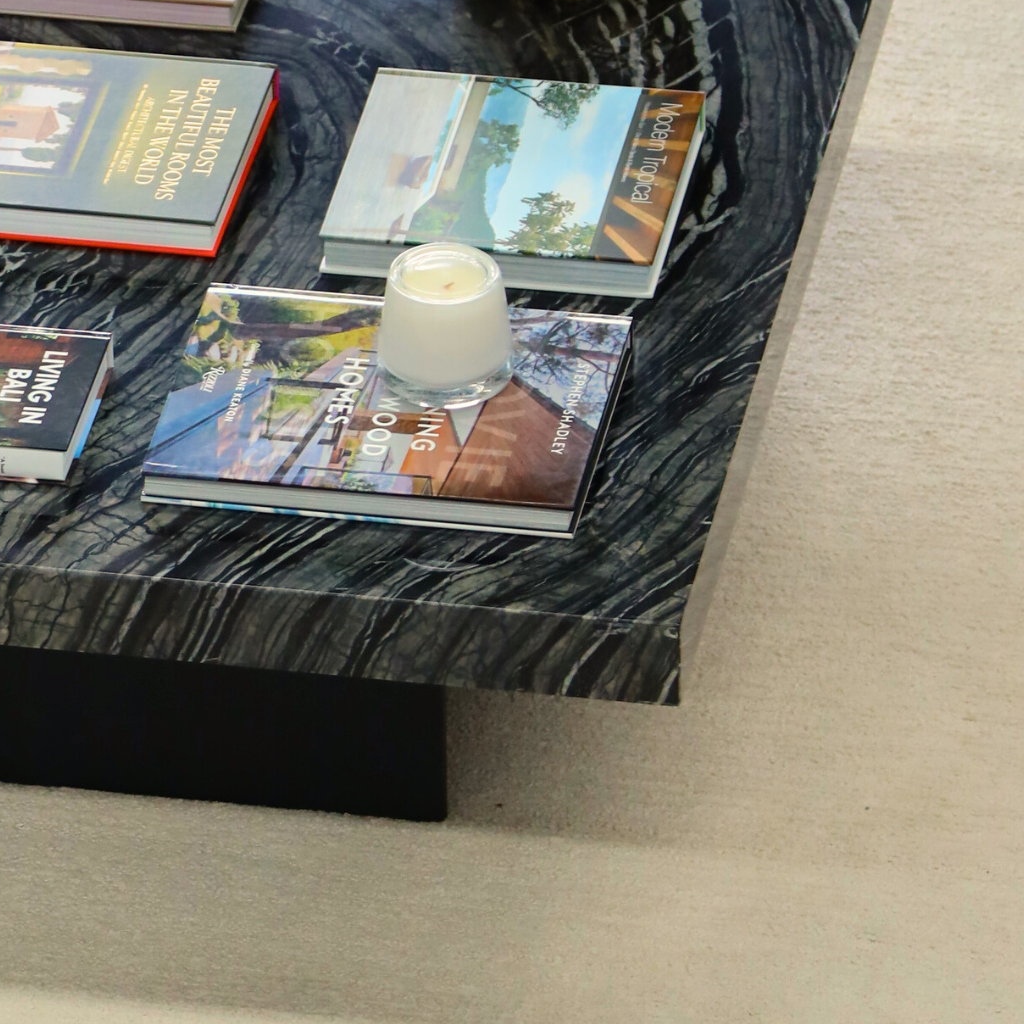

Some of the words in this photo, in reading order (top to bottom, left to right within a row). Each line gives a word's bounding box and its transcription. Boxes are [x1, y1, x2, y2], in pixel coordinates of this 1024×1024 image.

[166, 89, 189, 103] IN
[174, 78, 220, 149] BEAUTIFUL
[126, 97, 155, 150] ARCHITECTURAL
[154, 106, 182, 134] THE
[208, 107, 236, 135] THE
[646, 102, 683, 152] Modern
[117, 150, 135, 173] DIGEST
[134, 135, 170, 185] WORLD
[154, 151, 189, 200] ROOMS
[192, 137, 224, 176] MOST
[630, 155, 668, 204] Tropical
[27, 351, 68, 403] LIVING
[235, 368, 252, 391] DIANE
[324, 357, 370, 425] HOMES
[566, 362, 590, 406] STEPHEN
[18, 406, 46, 424] IN
[224, 392, 243, 422] KEATON
[362, 397, 403, 457] WOOD
[410, 407, 447, 452] NING
[551, 409, 576, 454] SHADLEY
